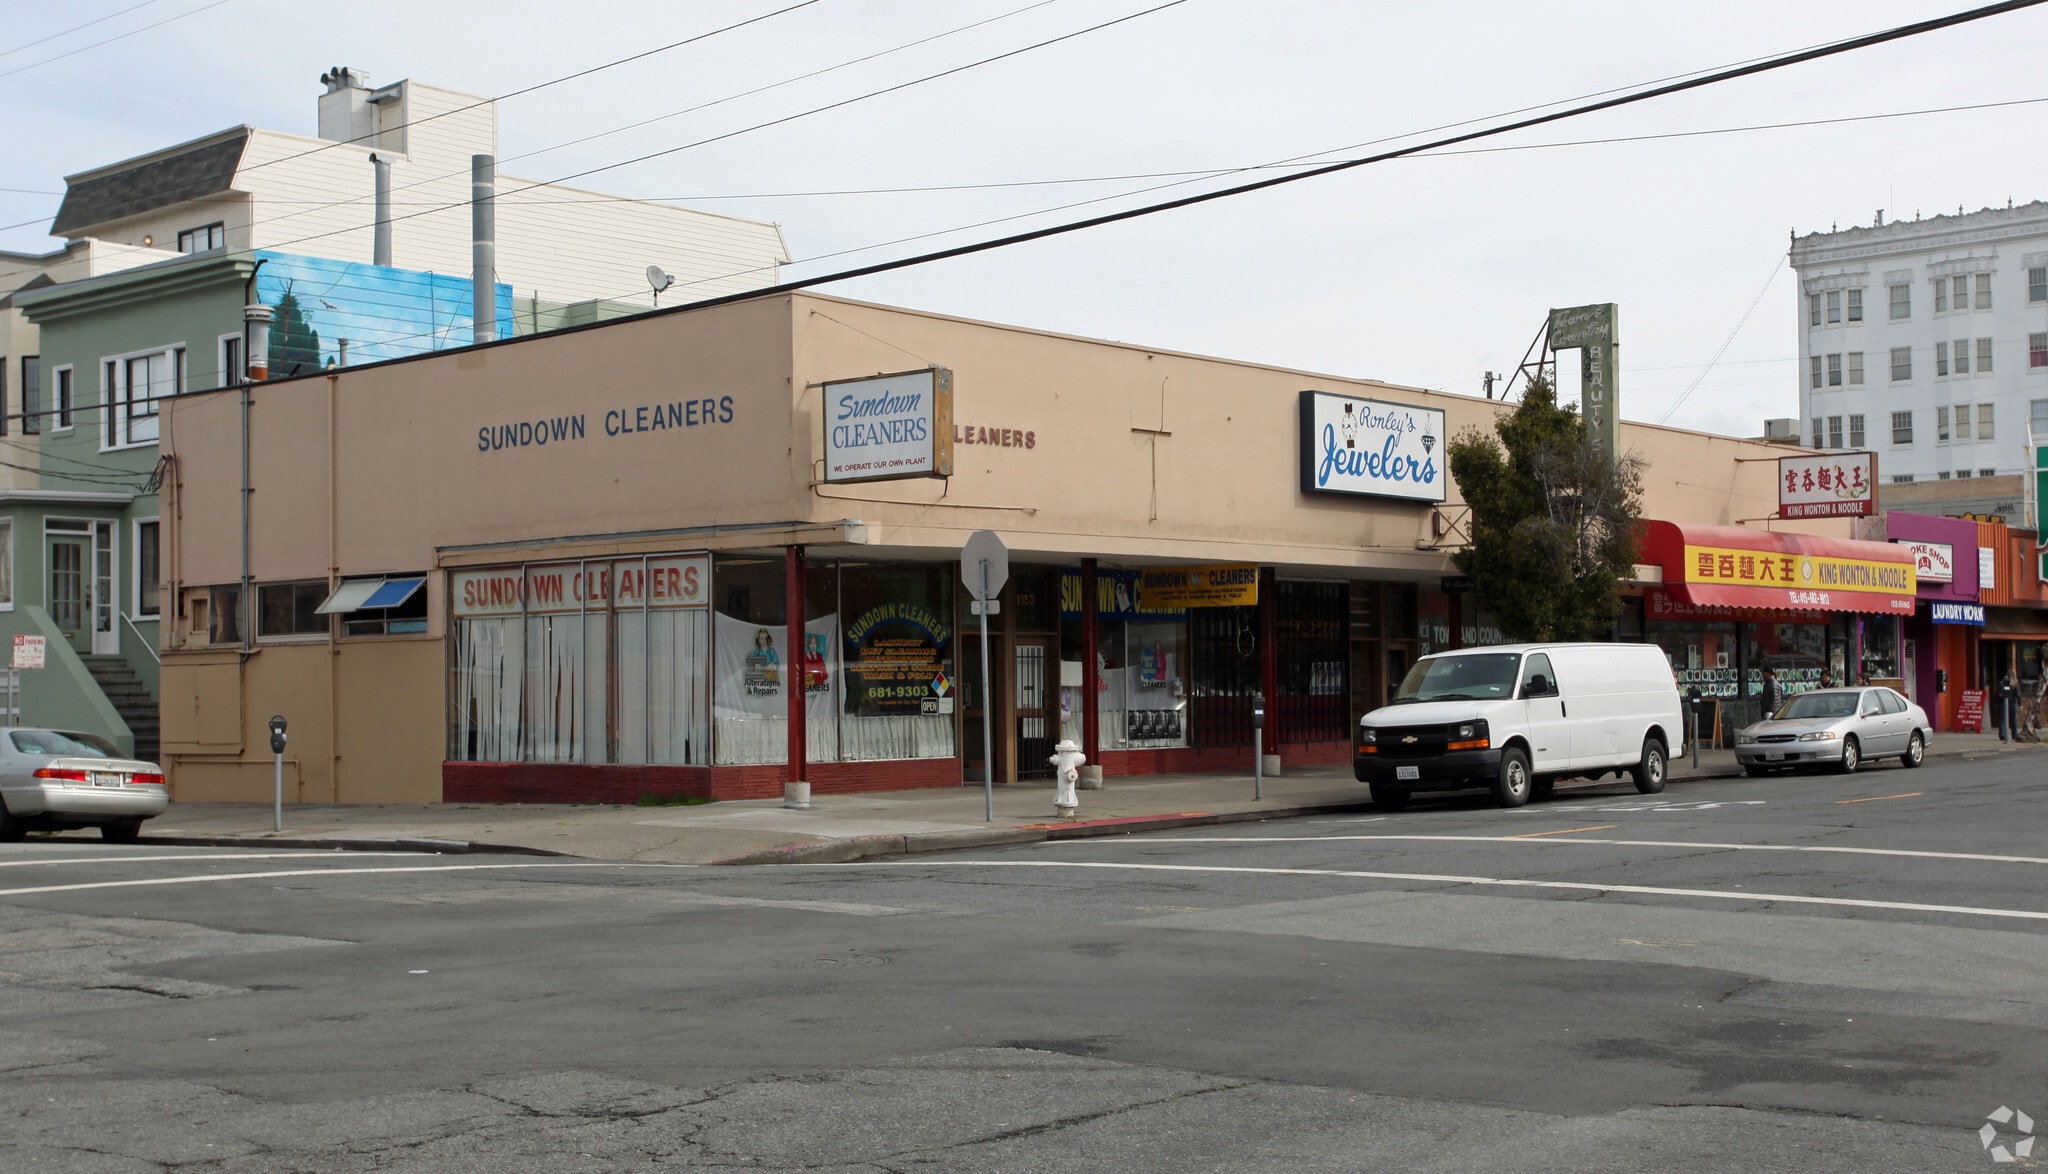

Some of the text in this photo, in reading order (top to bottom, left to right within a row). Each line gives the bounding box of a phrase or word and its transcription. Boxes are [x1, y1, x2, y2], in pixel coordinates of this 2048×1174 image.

[837, 389, 922, 420] Sundown
[477, 395, 734, 452] SUNDOWN CLEANERS
[832, 417, 928, 450] CLEANERS
[1359, 405, 1417, 448] Ronley's
[952, 424, 1037, 450] LEANERS
[833, 457, 927, 473] WE OPERATE OUR OWN PLANT
[1318, 422, 1438, 488] Jewelers
[1786, 502, 1864, 517] KING WONTON & NOODLE
[1910, 544, 1951, 570] OKE SHOP
[1144, 568, 1256, 588] SUNDOWN CLEANERS
[1818, 562, 1908, 590] KING WONTON & NOODLE
[463, 572, 564, 608] SUNDOWN
[1060, 574, 1116, 613] SUNWN
[848, 602, 948, 643] SUNDOWN CLEANERS
[1932, 603, 1985, 623] LAUNDRY WORK
[14, 636, 45, 646] NO PARKING
[744, 678, 781, 688] Alterations
[747, 686, 778, 697] & Repairs
[868, 685, 930, 698] 681-9303
[1141, 681, 1167, 689] CLEANERS
[921, 700, 938, 712] OPEN
